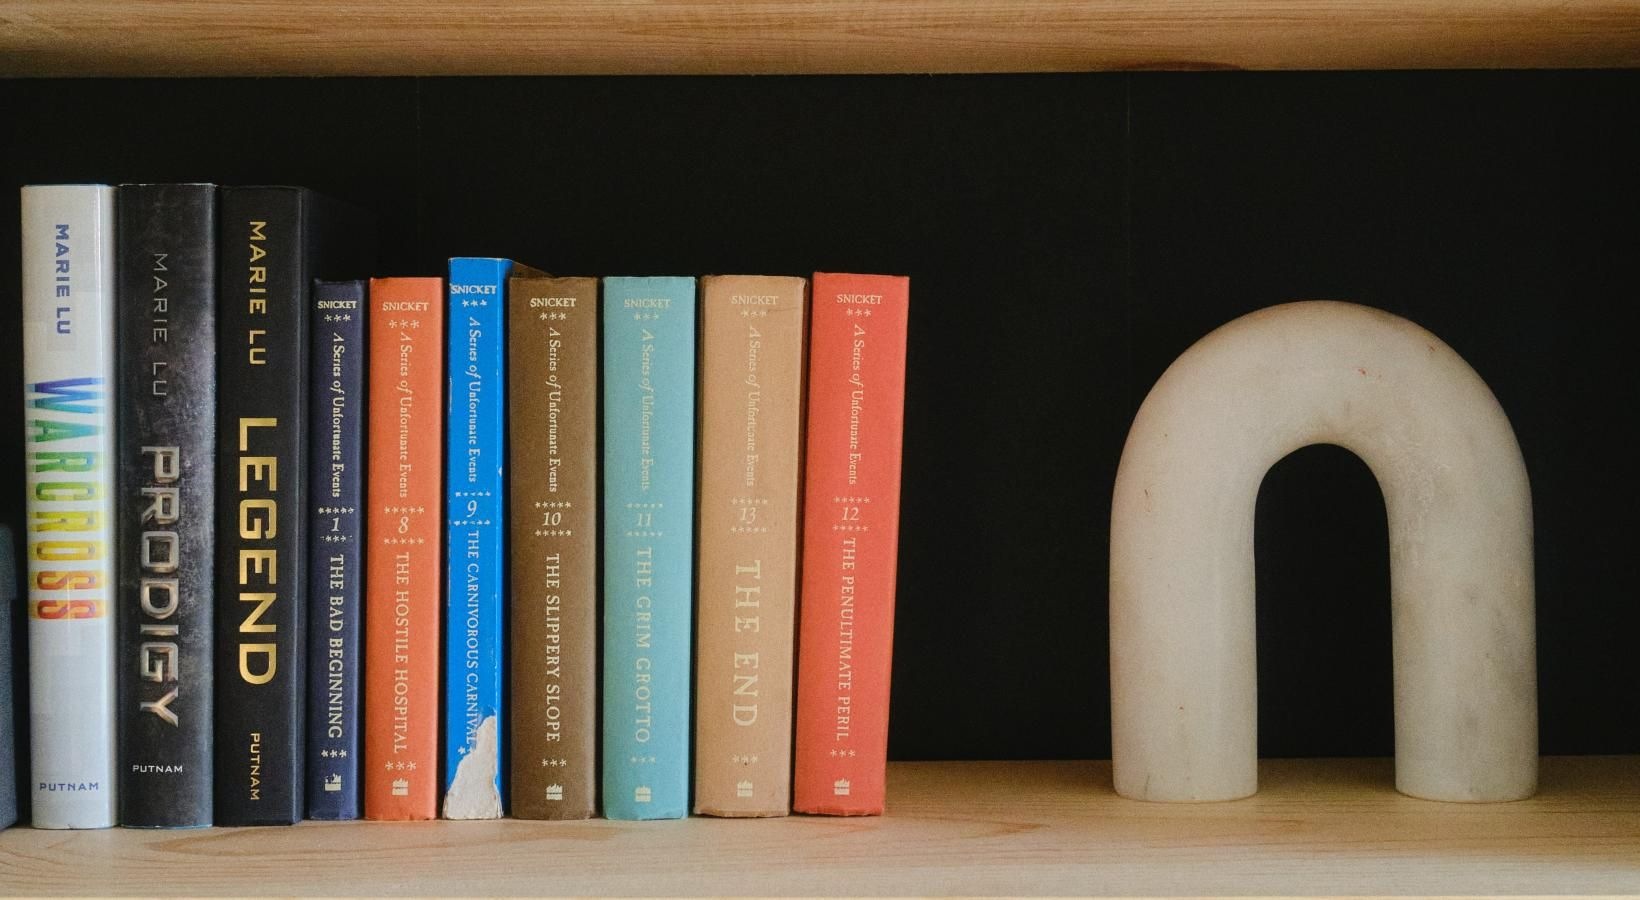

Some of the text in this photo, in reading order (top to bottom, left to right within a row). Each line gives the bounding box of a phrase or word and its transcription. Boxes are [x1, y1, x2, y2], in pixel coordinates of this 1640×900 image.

[56, 224, 70, 334] MARIE LU
[153, 254, 168, 396] MARIE LU
[250, 222, 266, 364] MARIE LU
[318, 300, 356, 309] SNICKET
[383, 302, 428, 311] SNICKET
[451, 285, 496, 294] SNICKET
[530, 298, 576, 307] SNICKET
[624, 299, 671, 308] SNICKET
[731, 296, 778, 305] SNICKET
[836, 294, 882, 304] SNICKET
[330, 333, 345, 497] A Series of Unfortunate Events
[397, 333, 412, 497] A Series of Unfortunate Events
[467, 317, 481, 482] A Series of Unfortunate Events
[546, 328, 561, 492] A Series of Unfortunate Events
[639, 330, 654, 490] A Series of Unfortunate Events
[746, 326, 761, 486] A Series of Unfortunate Events
[849, 324, 864, 484] A Series of Unfortunate Events
[26, 376, 107, 619] WARCROSS
[239, 417, 278, 685] LEGEND
[332, 517, 339, 531] 1
[398, 517, 409, 533] 8
[467, 501, 477, 517] 9
[467, 530, 479, 558] THE
[542, 512, 562, 526] 10
[637, 512, 651, 526] 11
[739, 508, 756, 524] 13
[842, 507, 859, 520] 12
[140, 446, 180, 728] PRODIGY
[467, 563, 479, 669] CARNIVOROUS
[837, 538, 856, 741] THE PENULTIMATE PERIL
[328, 554, 344, 738] THE BAD BEGINNING
[394, 552, 409, 754] THE HOSTILE HOSPITAL
[546, 553, 560, 742] THE SLIPPERY SLOPE
[635, 547, 652, 743] THE GRIM GROTTO
[733, 560, 760, 726] THE END
[39, 782, 99, 791] PUTNAM
[133, 765, 183, 773] PUTNAM
[250, 733, 260, 800] PUTNAM
